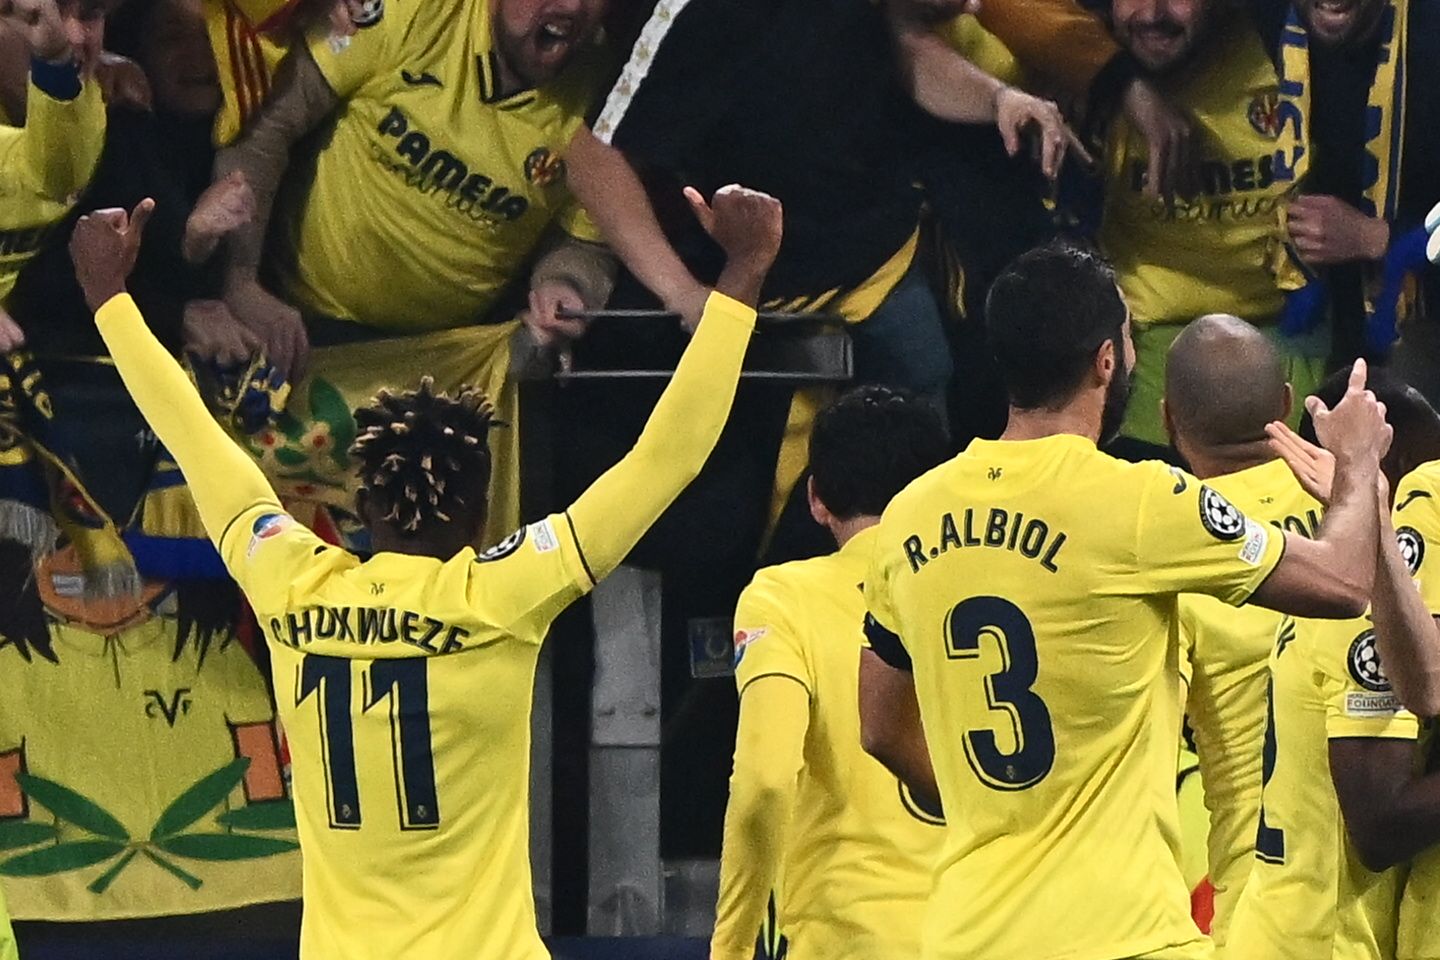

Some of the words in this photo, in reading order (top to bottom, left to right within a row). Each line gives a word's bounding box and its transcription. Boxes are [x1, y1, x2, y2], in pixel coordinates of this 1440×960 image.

[377, 104, 529, 222] PAMESA
[902, 507, 1068, 574] R.ALBIOL
[294, 652, 440, 832] 11
[943, 595, 1057, 792] 3
